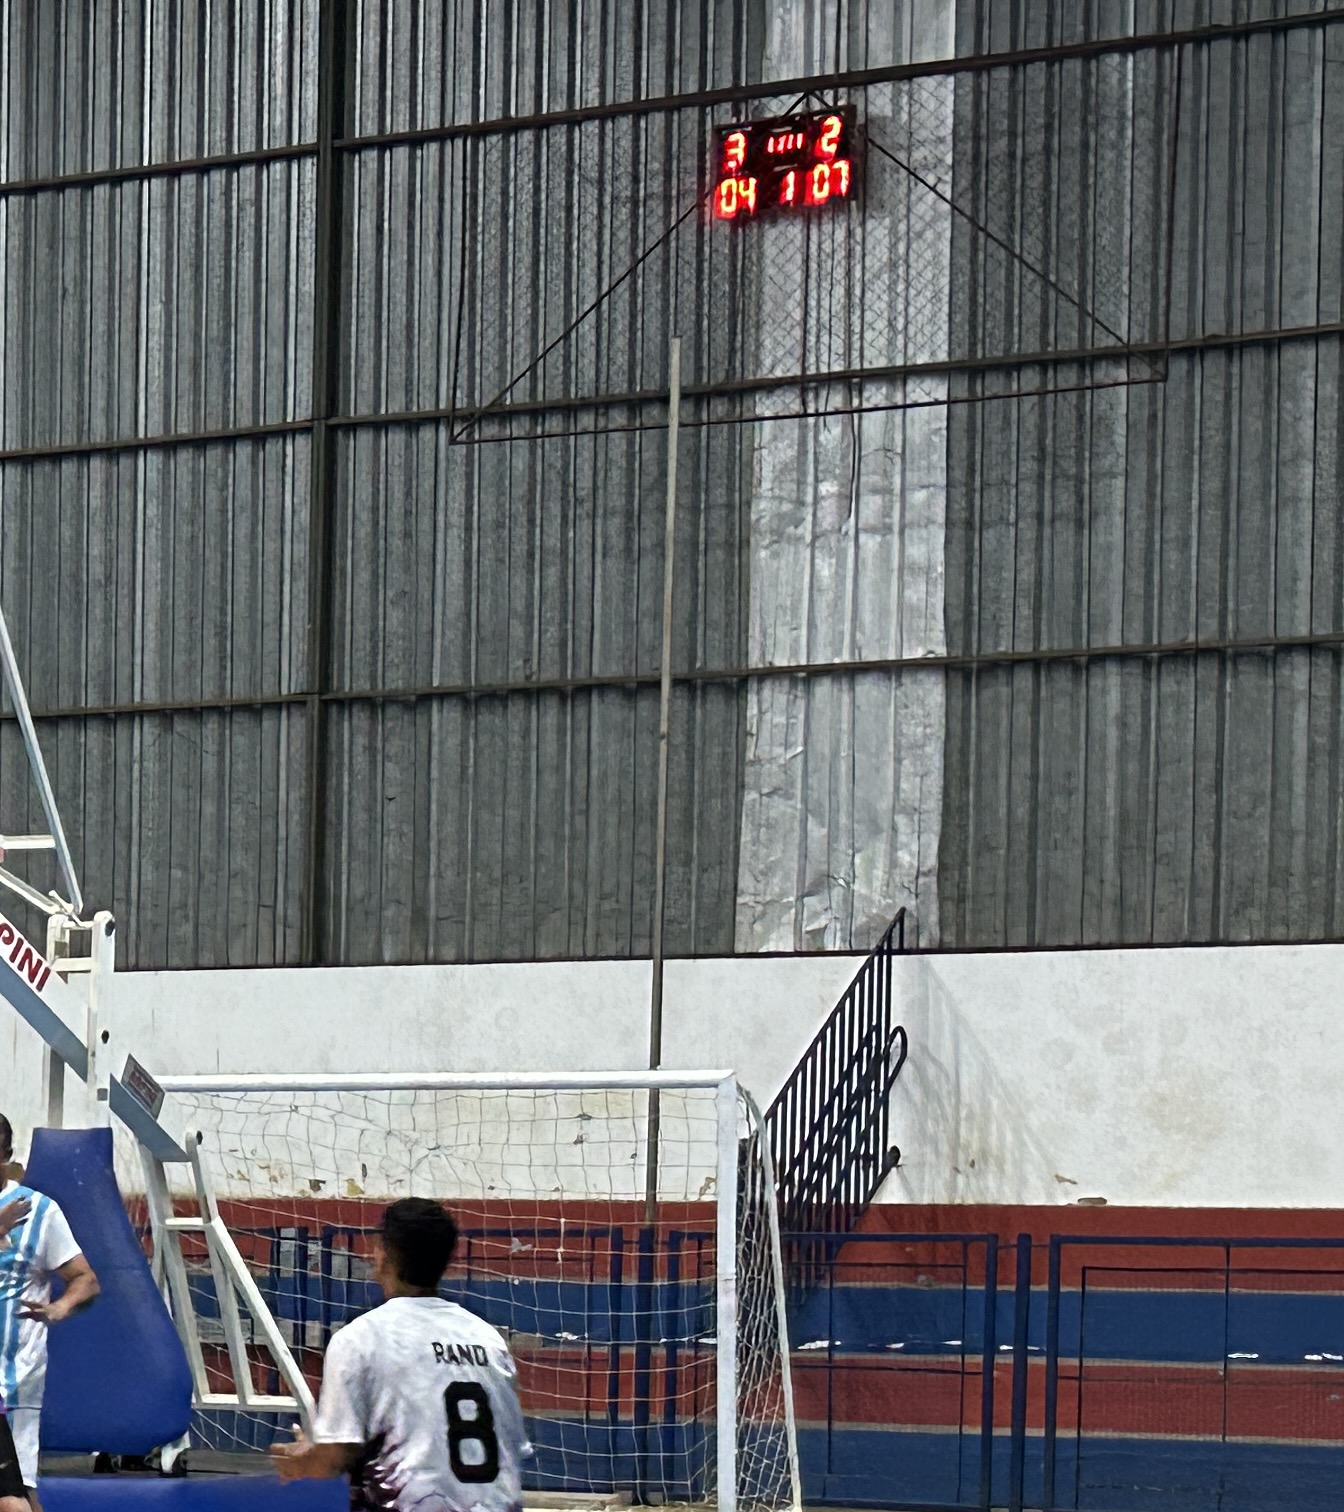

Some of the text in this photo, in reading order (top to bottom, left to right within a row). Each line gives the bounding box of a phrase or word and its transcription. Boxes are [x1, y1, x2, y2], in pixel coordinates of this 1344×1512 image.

[725, 131, 747, 170] 3
[820, 115, 843, 156] 2
[719, 176, 758, 216] 04
[444, 1381, 500, 1484] 8
